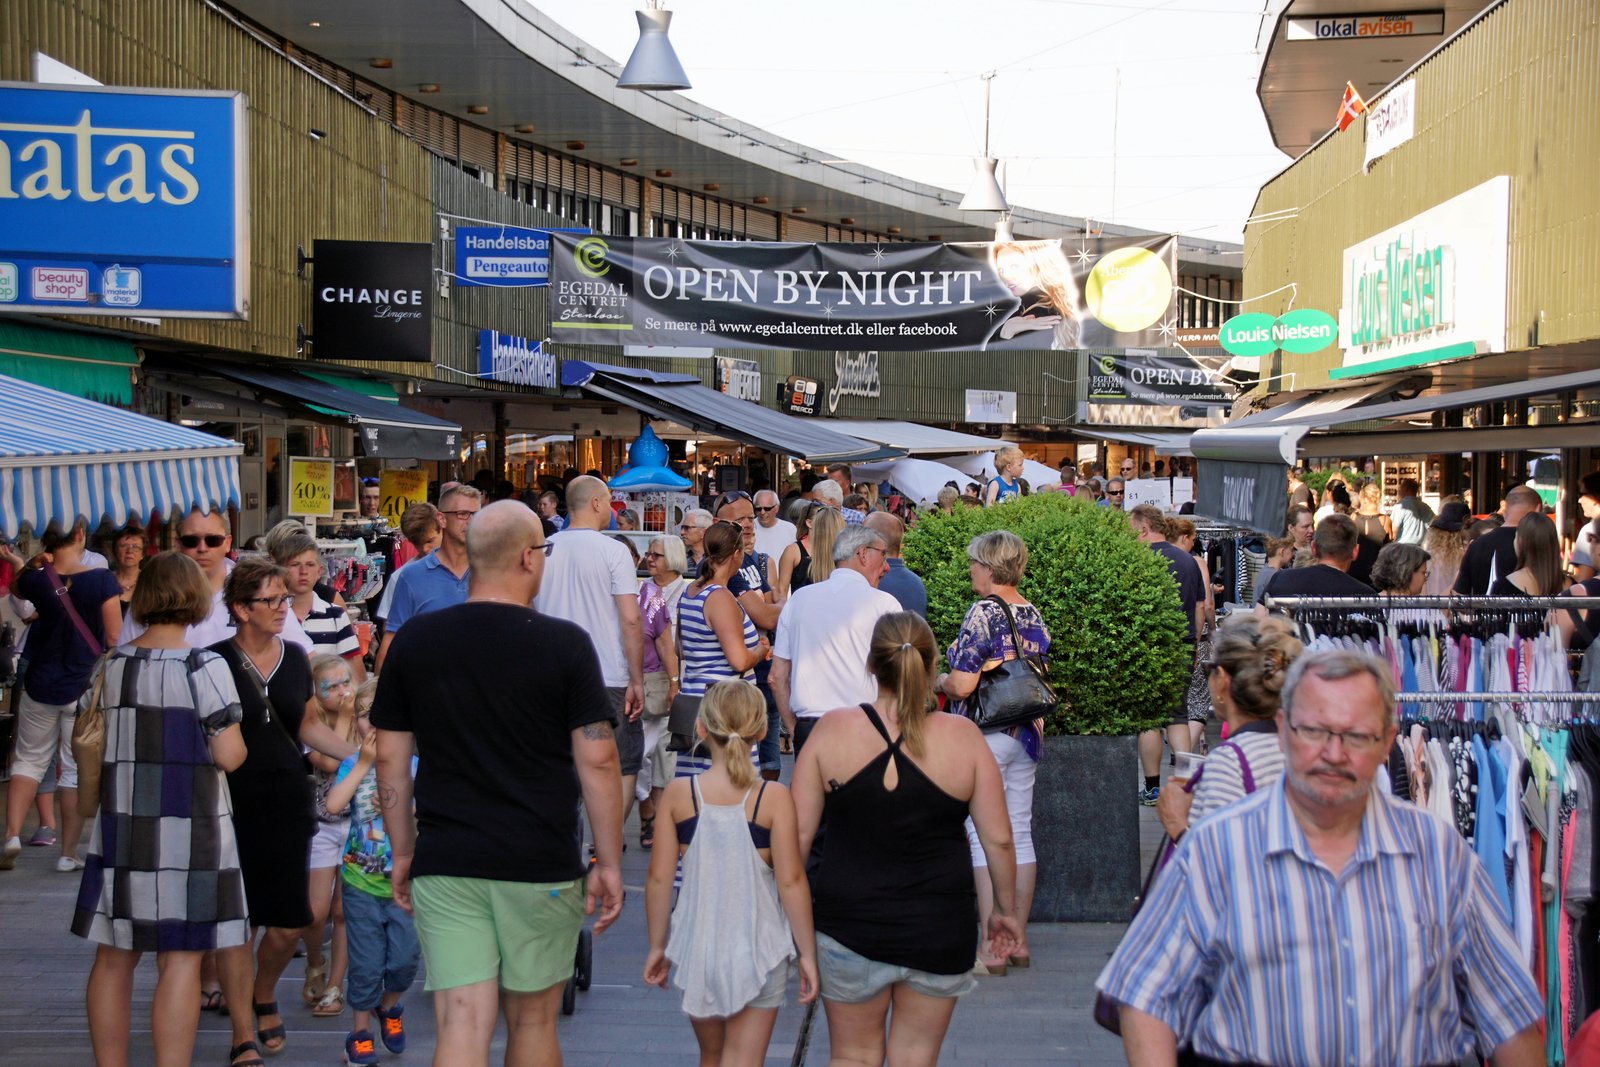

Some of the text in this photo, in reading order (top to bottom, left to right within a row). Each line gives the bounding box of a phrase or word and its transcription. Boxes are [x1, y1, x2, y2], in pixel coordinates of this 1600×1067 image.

[473, 258, 549, 277] Pengeauto
[38, 268, 83, 287] beauty
[643, 265, 982, 306] OPEN BY NIGHT
[45, 283, 76, 299] shop
[107, 288, 137, 296] material
[322, 287, 422, 305] CHANGE
[559, 281, 628, 297] EGEDAL
[558, 296, 628, 307] CENTRET
[374, 305, 422, 323] Lingerie
[645, 318, 957, 337] Se mere på www.egedalcentret.dk eller facebook
[1227, 323, 1330, 344] Louis Nielsen
[1092, 375, 1124, 384] EGEDAL
[1131, 367, 1216, 387] OPEN BY
[292, 482, 331, 500] 40%
